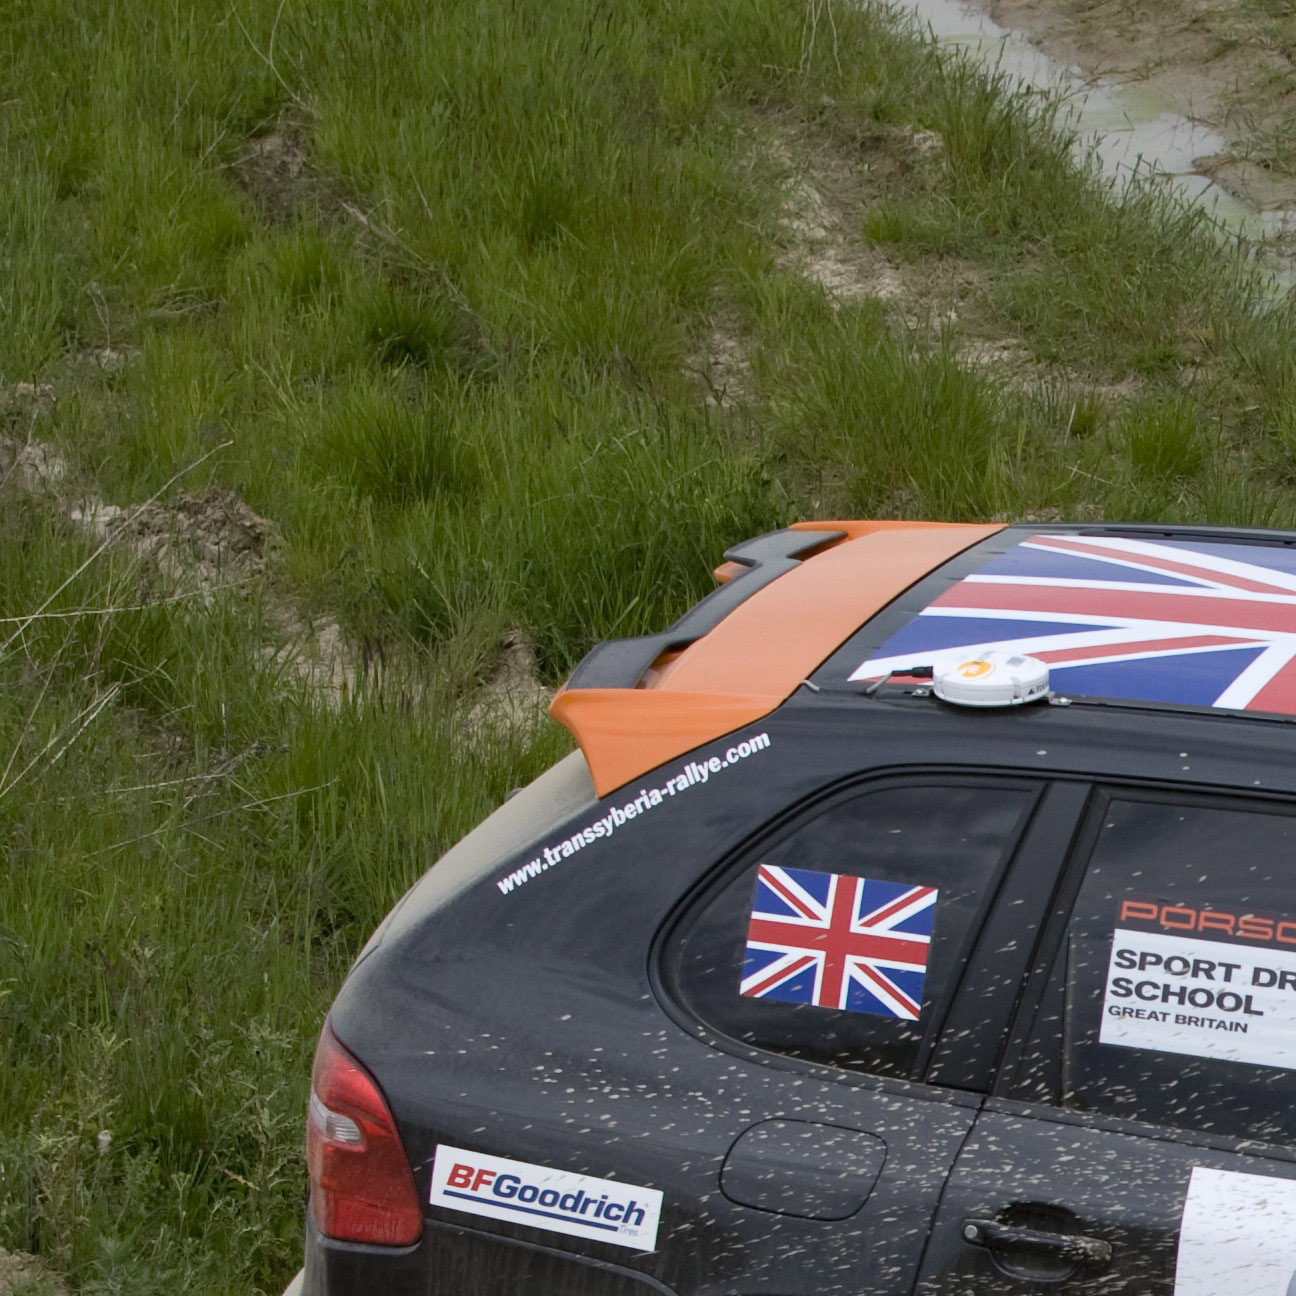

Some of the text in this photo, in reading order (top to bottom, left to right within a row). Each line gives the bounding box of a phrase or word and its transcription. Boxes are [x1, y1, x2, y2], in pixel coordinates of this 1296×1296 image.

[496, 731, 772, 897] www.transsyberia-rallye.com
[1113, 948, 1242, 984] SPORT
[1108, 977, 1265, 1017] SCHOOL
[1107, 1005, 1249, 1034] GREAT BRITAIN
[446, 1163, 646, 1226] BFGoodrich
[619, 1224, 639, 1237] Tires
